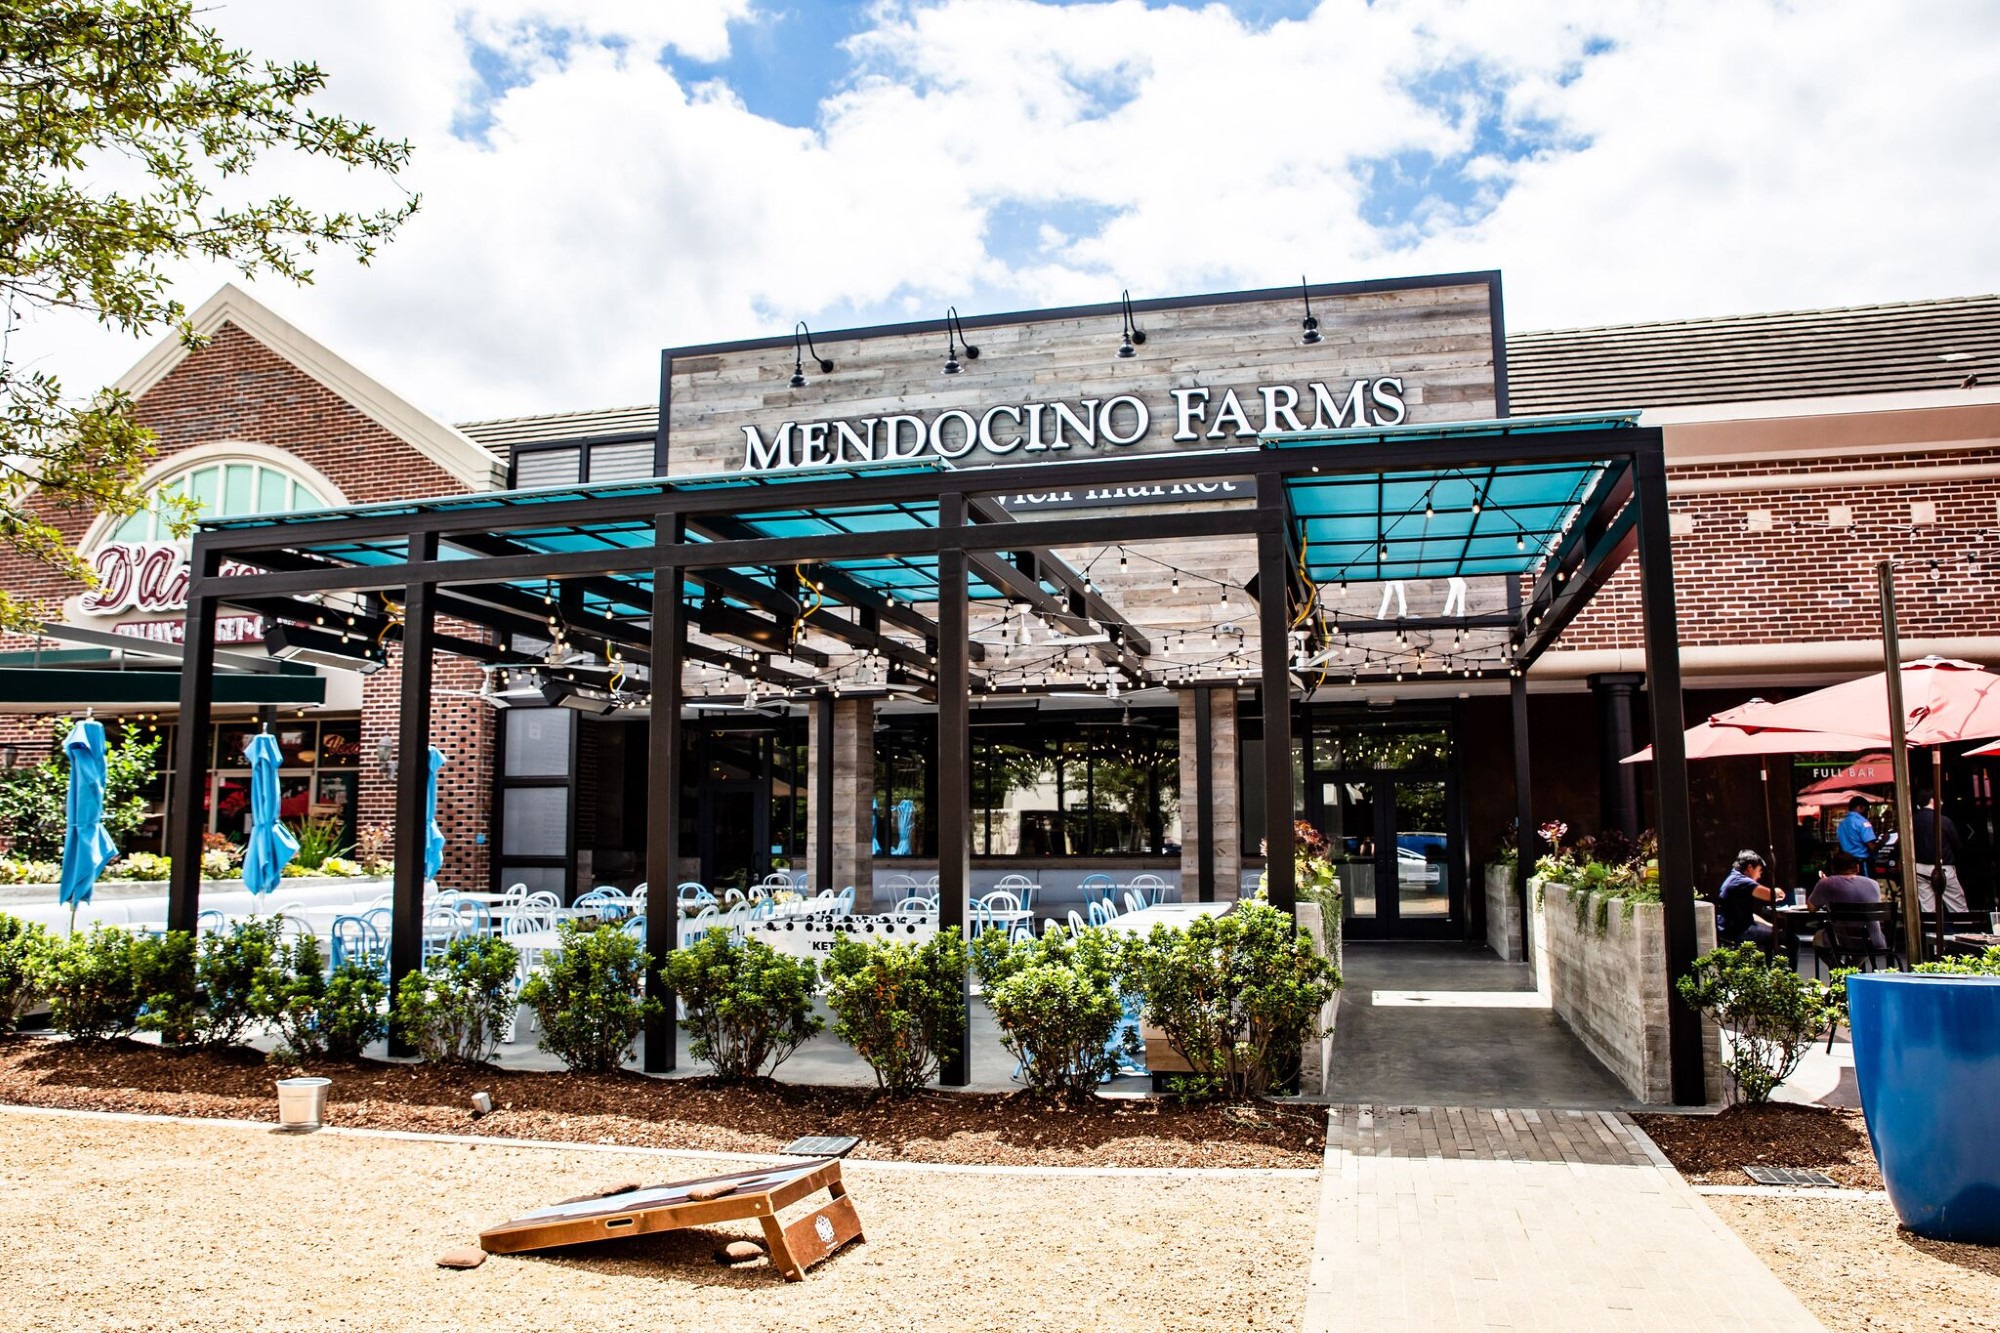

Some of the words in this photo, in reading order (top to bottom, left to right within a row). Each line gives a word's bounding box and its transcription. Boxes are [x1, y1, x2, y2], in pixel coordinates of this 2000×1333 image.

[739, 393, 1150, 472] MENDOCINO
[1169, 377, 1406, 442] FARMS
[1813, 768, 1844, 778] FULL
[1848, 767, 1875, 778] BAR
